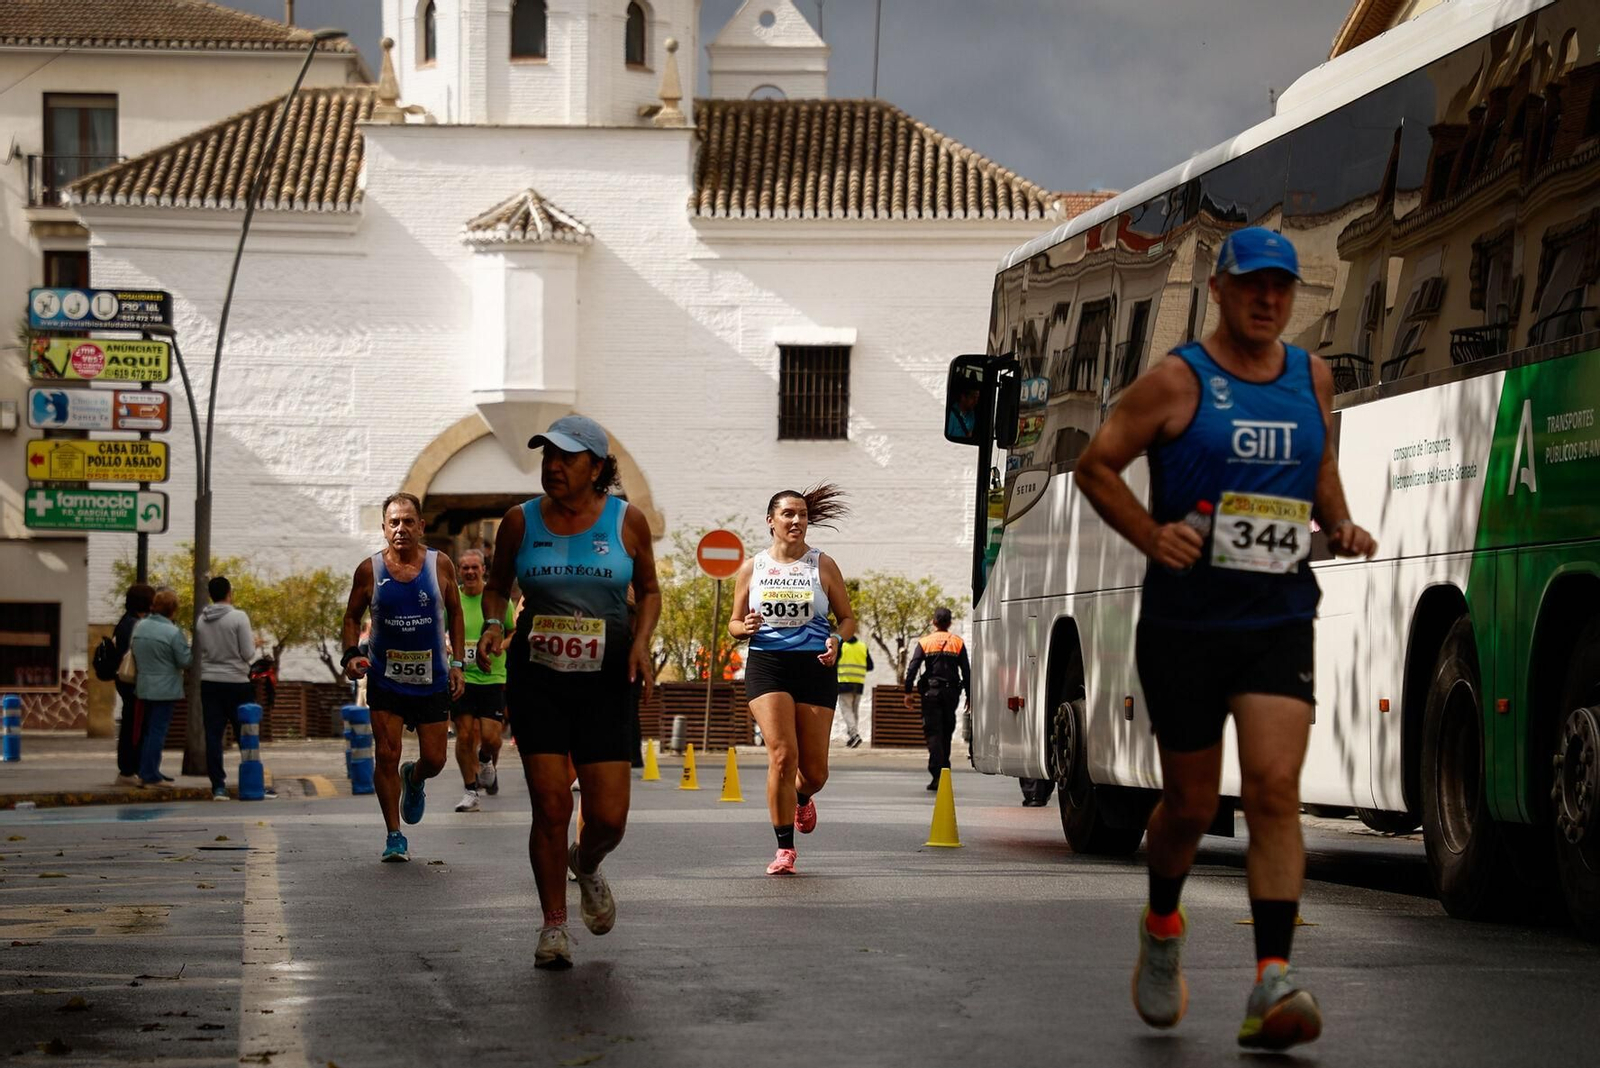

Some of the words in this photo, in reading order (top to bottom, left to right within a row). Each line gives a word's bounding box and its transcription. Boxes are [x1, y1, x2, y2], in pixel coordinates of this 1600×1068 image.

[108, 355, 161, 368] AQUÍ
[114, 369, 129, 378] 619
[131, 370, 146, 378] 472
[1547, 408, 1595, 433] TRANSPORTES
[98, 443, 128, 455] CASA
[131, 443, 152, 455] DEL
[1424, 437, 1451, 458] Transporte
[1579, 441, 1588, 458] DE
[87, 456, 122, 467] POLLO
[125, 456, 162, 468] ASADO
[1455, 461, 1477, 480] Granada
[1016, 482, 1036, 495] SETRA
[57, 492, 134, 509] farmacia
[1232, 520, 1299, 555] 344
[524, 564, 613, 578] ALMUÑÉCAR
[759, 578, 811, 586] MARACENA
[762, 602, 809, 617] 3031
[531, 633, 599, 659] 2061
[391, 662, 426, 676] 956
